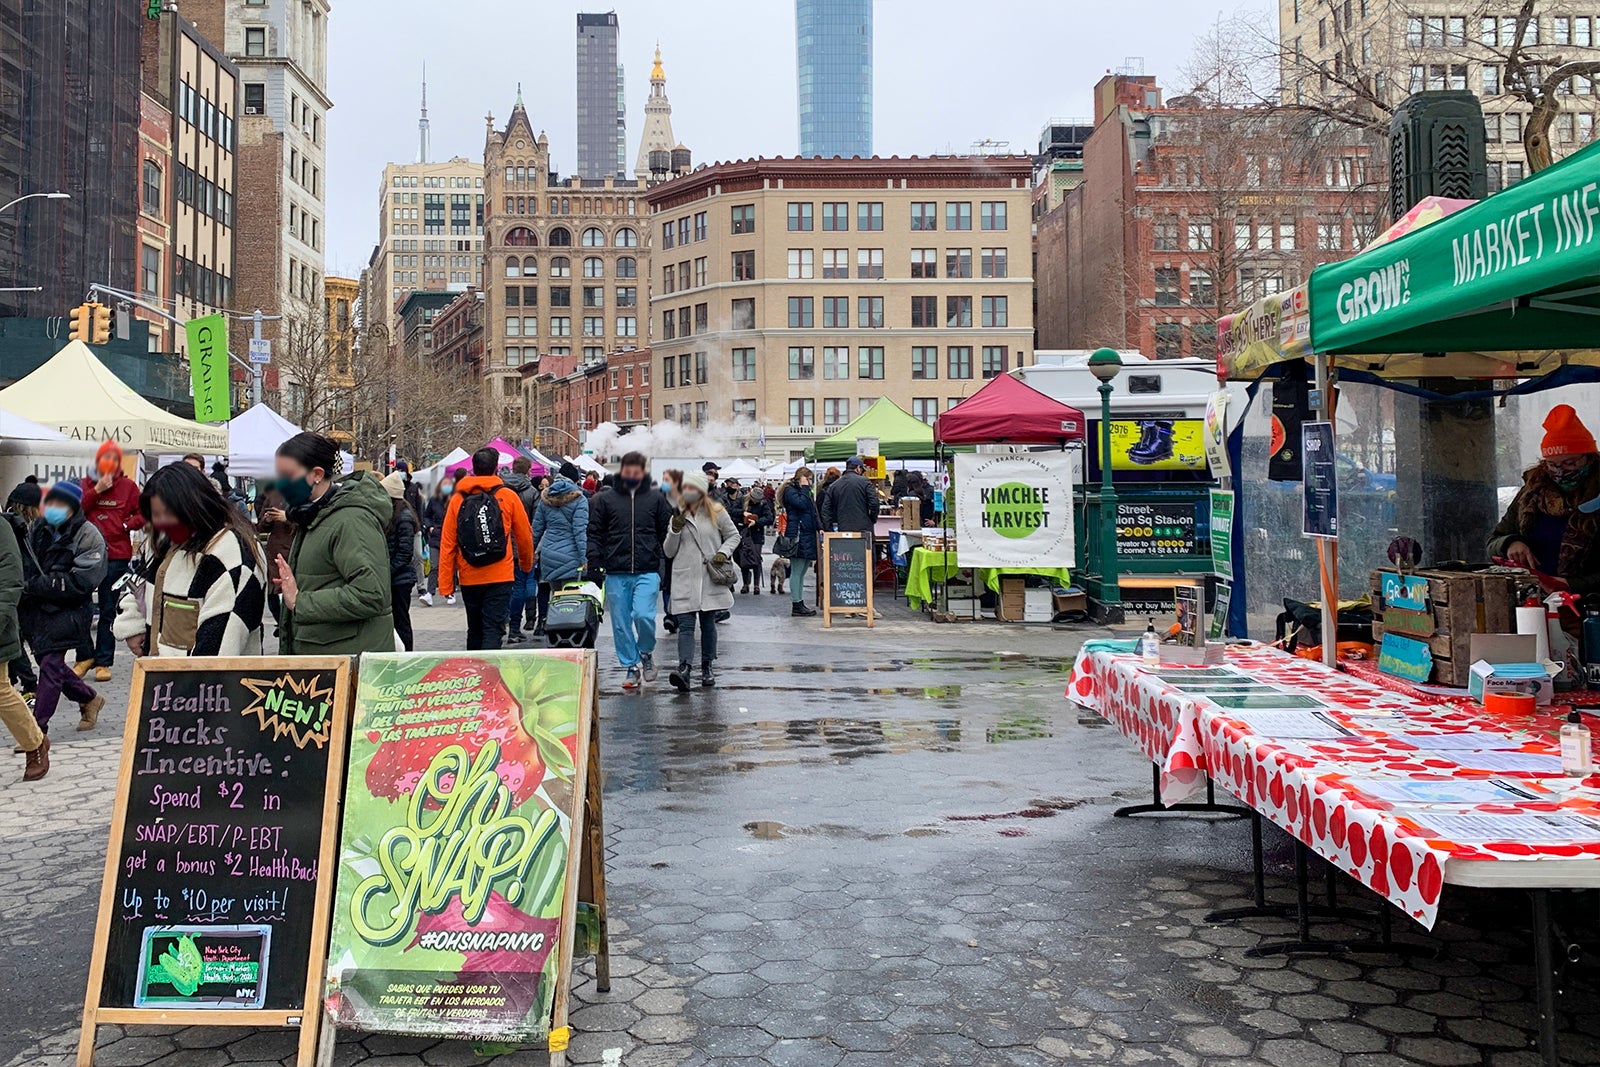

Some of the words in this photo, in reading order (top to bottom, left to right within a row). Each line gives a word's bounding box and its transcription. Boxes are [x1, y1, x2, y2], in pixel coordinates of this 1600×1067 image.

[1452, 202, 1545, 287] MARKET
[1552, 182, 1600, 254] INF
[1336, 262, 1401, 325] GROW
[1400, 257, 1411, 305] NYC
[1253, 312, 1277, 342] HERE
[197, 326, 213, 417] GRAINS
[58, 425, 133, 442] FARMS
[977, 460, 993, 473] EAST
[996, 455, 1025, 463] BRANCH
[1027, 458, 1050, 472] FARMS
[980, 487, 1049, 505] KIMCHEE
[981, 511, 1050, 528] HARVEST
[1118, 504, 1154, 514] Street-
[1116, 515, 1135, 525] ion
[1137, 515, 1153, 527] Sq
[1145, 602, 1159, 610] buy
[151, 681, 231, 712] Health
[378, 684, 403, 699] LOS
[403, 676, 464, 696] MERCADOS
[467, 676, 482, 688] DE
[265, 688, 330, 731] NEW!
[374, 699, 416, 714] FRUTAS
[416, 698, 427, 709] Y
[427, 690, 485, 706] VERDURAS
[371, 716, 394, 729] DEL
[395, 705, 481, 726] GREENMARKET
[148, 717, 229, 745] Bucks
[381, 730, 402, 743] LAS
[404, 722, 457, 740] TARJETAS
[459, 719, 482, 733] EBT
[150, 784, 201, 812] Spend
[218, 780, 245, 809] $2
[263, 788, 281, 811] in
[407, 739, 511, 839] Oh
[126, 850, 147, 878] get
[156, 858, 166, 873] a
[176, 850, 216, 876] bonus
[224, 851, 244, 876] $2
[350, 808, 560, 948] SNAP!
[123, 888, 143, 916] Up
[153, 888, 171, 910] to
[181, 887, 207, 912] $10
[211, 897, 236, 922] per
[243, 887, 290, 917] visit!
[205, 946, 217, 954] New
[229, 945, 241, 956] City
[420, 931, 546, 952] #OHSNAPNYC
[177, 953, 193, 968] $2
[236, 988, 256, 998] NYC
[379, 995, 412, 1005] TARJETA
[413, 996, 428, 1005] EBT
[430, 996, 442, 1005] EN
[444, 996, 460, 1005] LOS
[461, 996, 506, 1006] MERCADOS
[415, 984, 431, 994] QUE
[433, 984, 464, 994] PUEDES
[465, 984, 487, 994] USAR
[489, 985, 501, 995] TU
[394, 1007, 406, 1017] DE
[407, 1008, 438, 1018] FRUTAS
[438, 1008, 445, 1018] Y
[446, 1008, 488, 1018] VERDURAS
